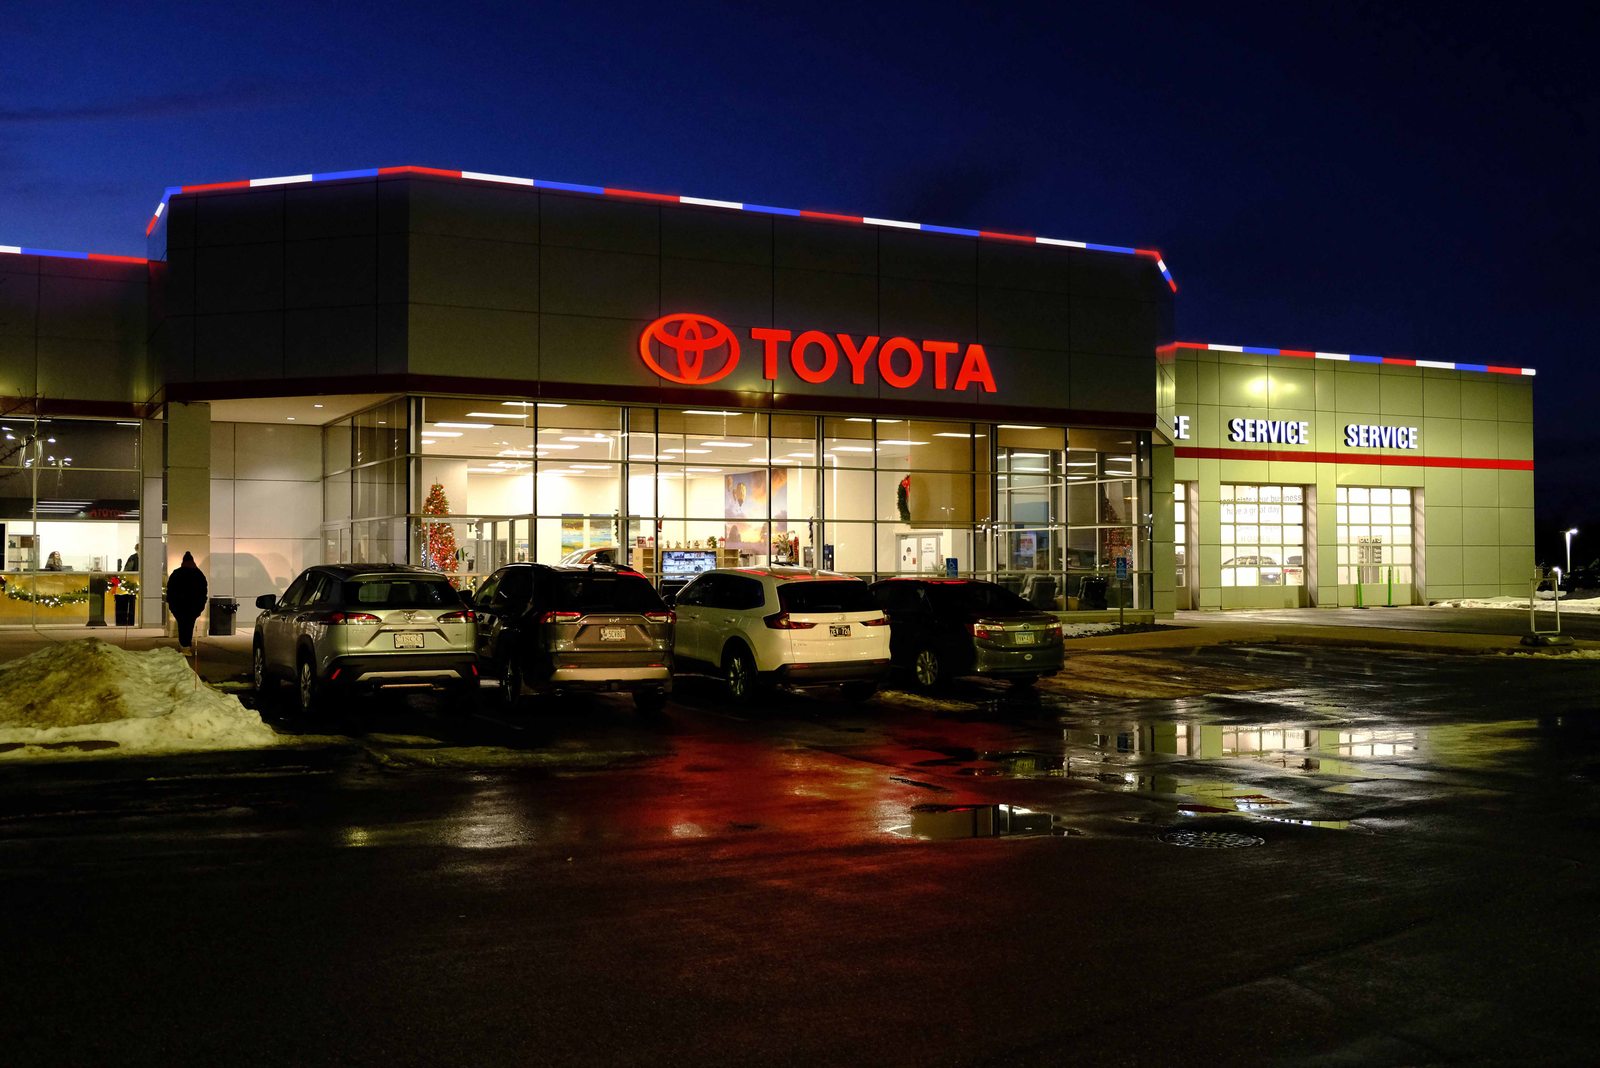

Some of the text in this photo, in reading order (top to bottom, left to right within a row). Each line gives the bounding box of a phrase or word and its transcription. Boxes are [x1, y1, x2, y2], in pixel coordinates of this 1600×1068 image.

[751, 327, 998, 393] TOYOTA
[1230, 417, 1309, 445] SERVICE
[1345, 423, 1419, 450] SERVICE
